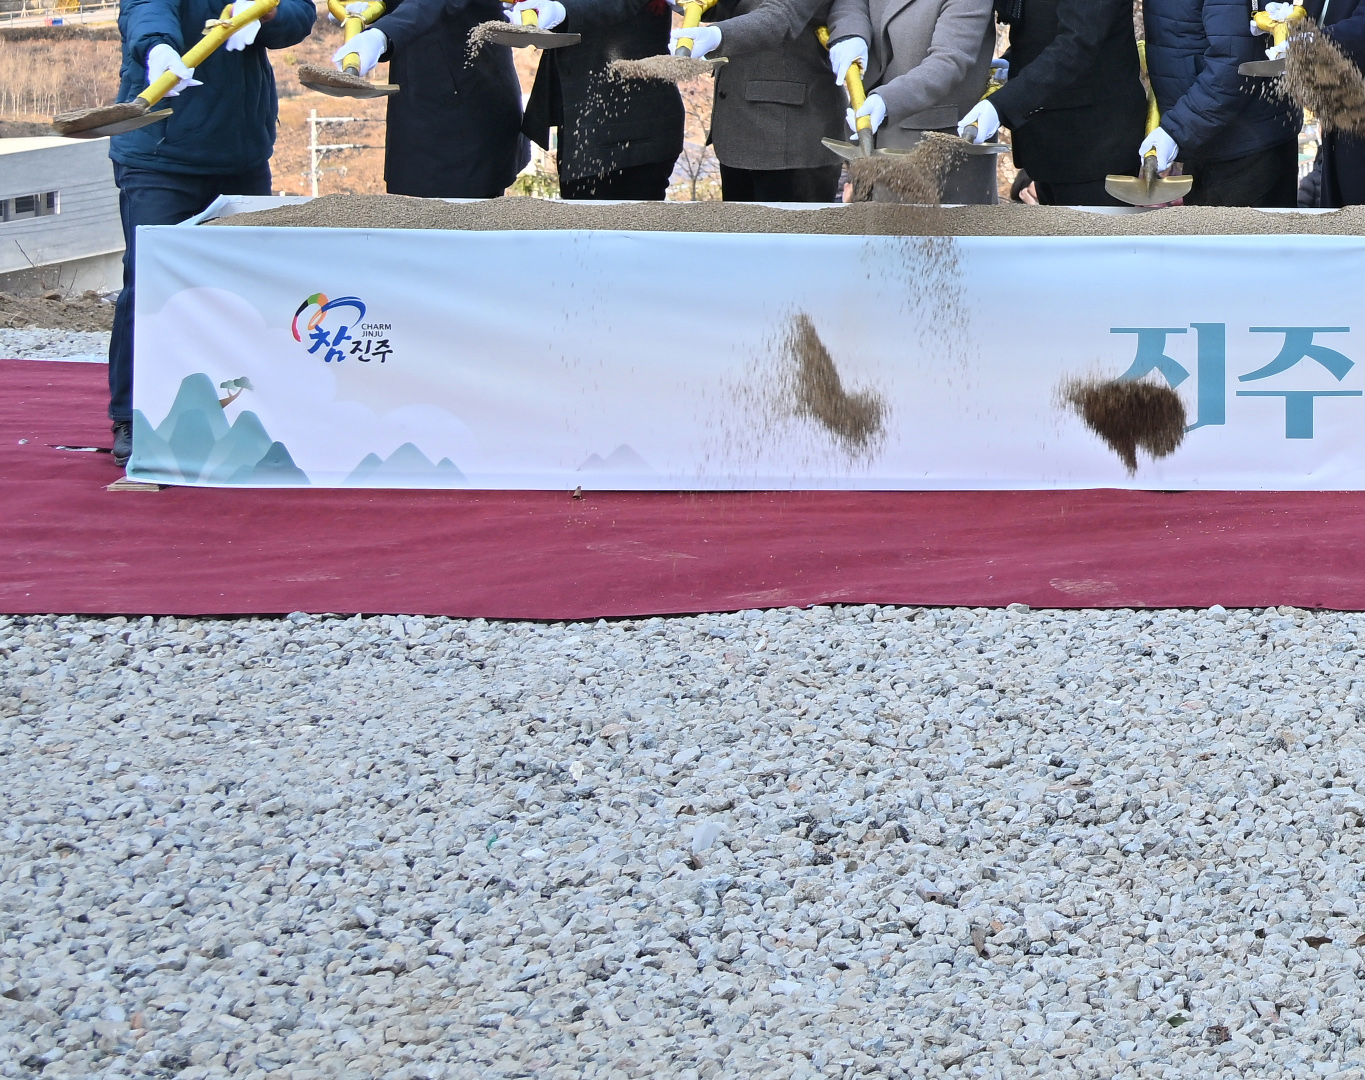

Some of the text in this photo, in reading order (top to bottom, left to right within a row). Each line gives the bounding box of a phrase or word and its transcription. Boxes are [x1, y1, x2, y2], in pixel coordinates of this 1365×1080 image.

[361, 323, 392, 331] CHARM
[361, 330, 384, 338] JINJU
[307, 324, 394, 363] 참 진주
